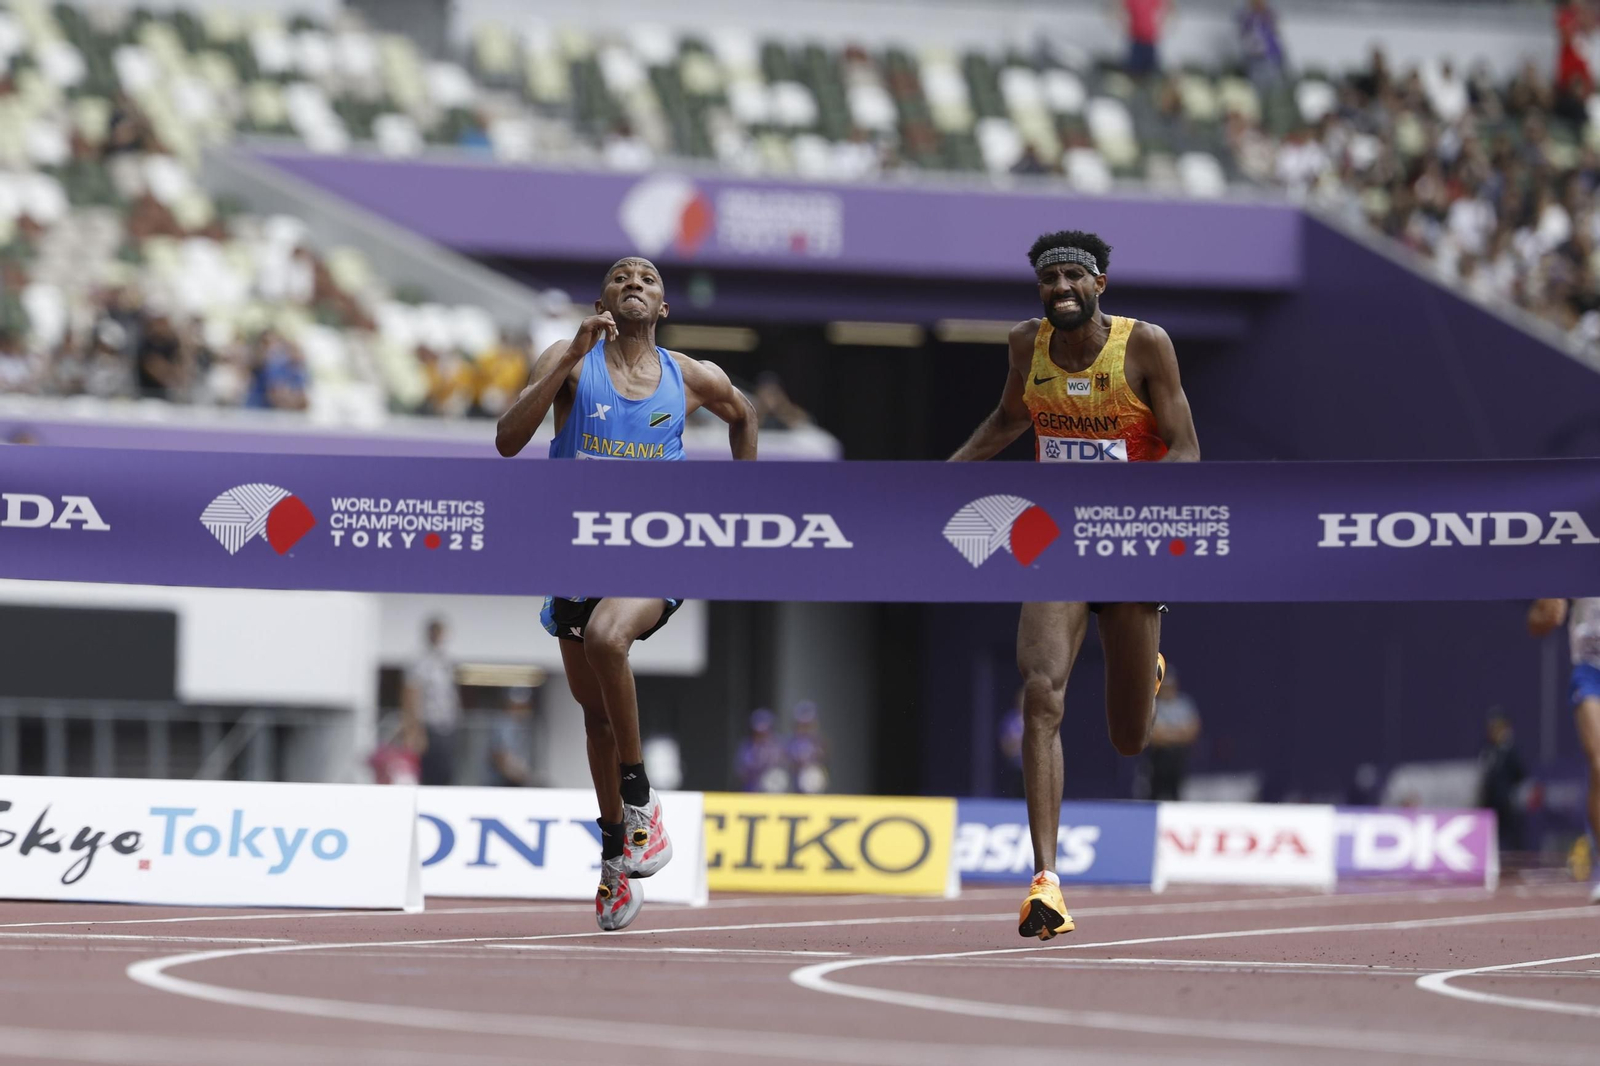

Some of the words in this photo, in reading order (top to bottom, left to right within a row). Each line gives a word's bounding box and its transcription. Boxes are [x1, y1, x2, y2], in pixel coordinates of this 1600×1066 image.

[1068, 382, 1090, 391] WGV
[1037, 411, 1118, 432] GERMANY
[582, 433, 665, 459] TANZANIA
[1060, 440, 1120, 461] TDK
[1, 493, 110, 531] DA
[331, 497, 391, 513] WORLD
[394, 499, 485, 515] ATHLETICS
[1074, 506, 1136, 520] WORLD
[1139, 506, 1230, 520] ATHLETICS
[330, 513, 485, 533] CHAMPIONSHIPS
[572, 511, 853, 549] HONDA
[1073, 521, 1230, 538] CHAMPIONSHIPS
[1318, 511, 1600, 547] HONDA
[0, 800, 144, 885] okyo
[149, 807, 348, 875] Tokyo
[953, 822, 1101, 875] asis
[1335, 812, 1477, 872] DK
